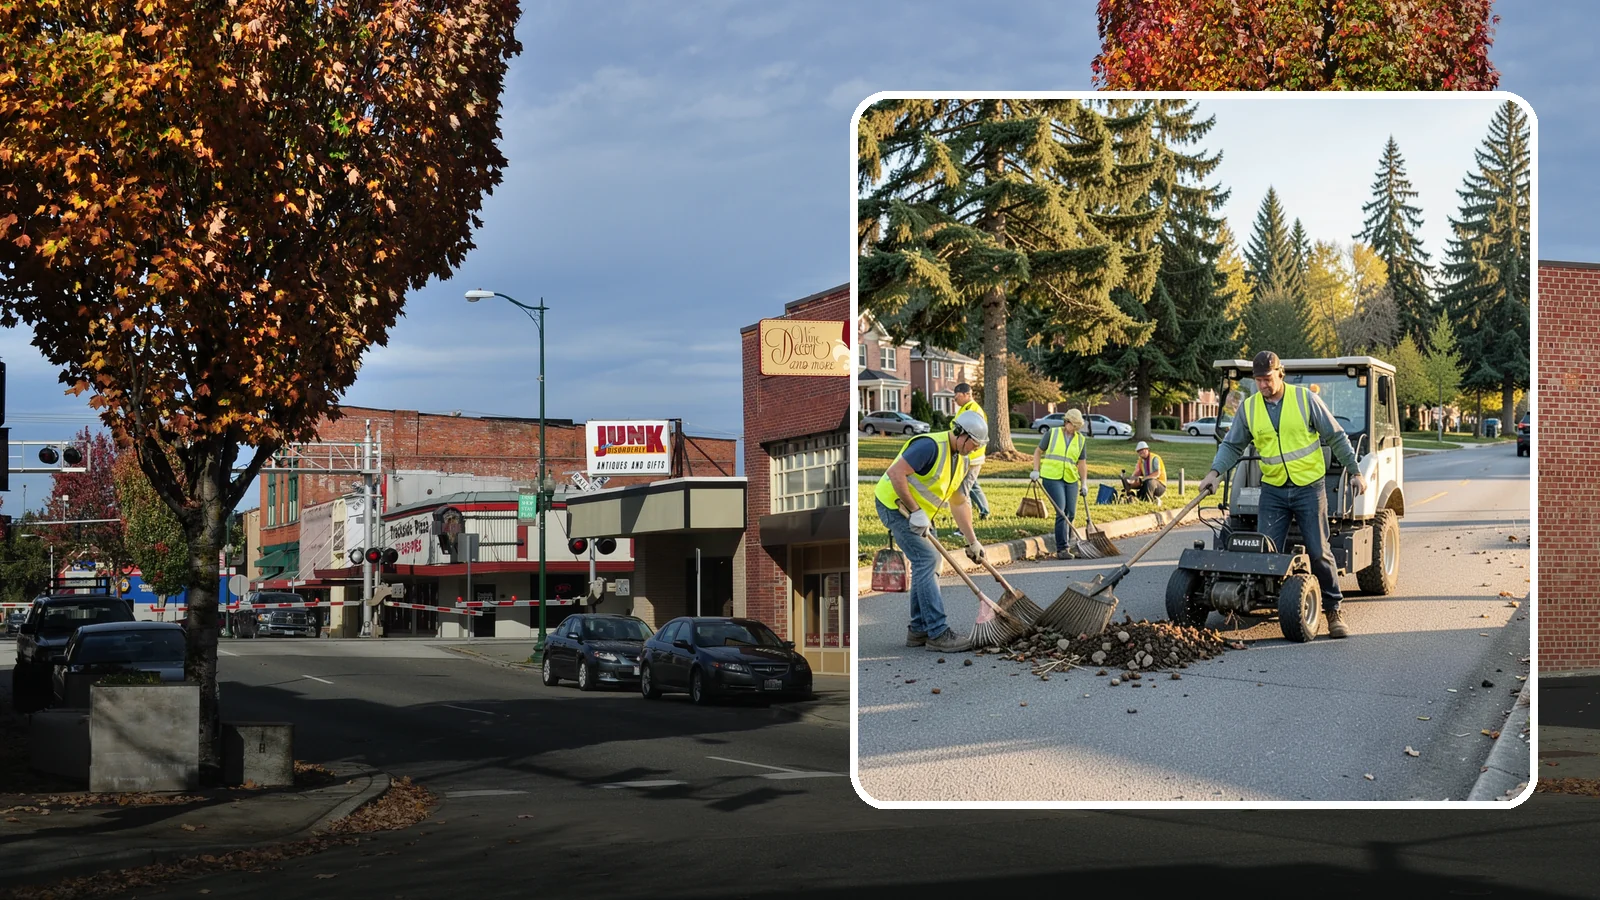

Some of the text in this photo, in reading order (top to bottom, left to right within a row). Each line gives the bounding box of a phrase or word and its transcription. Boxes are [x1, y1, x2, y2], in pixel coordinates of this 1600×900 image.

[595, 425, 665, 457] JUNK
[607, 446, 646, 454] DISORDERLY
[596, 460, 665, 470] ANTIQUES AND GIFTS
[390, 519, 429, 540] Trackside Pizza
